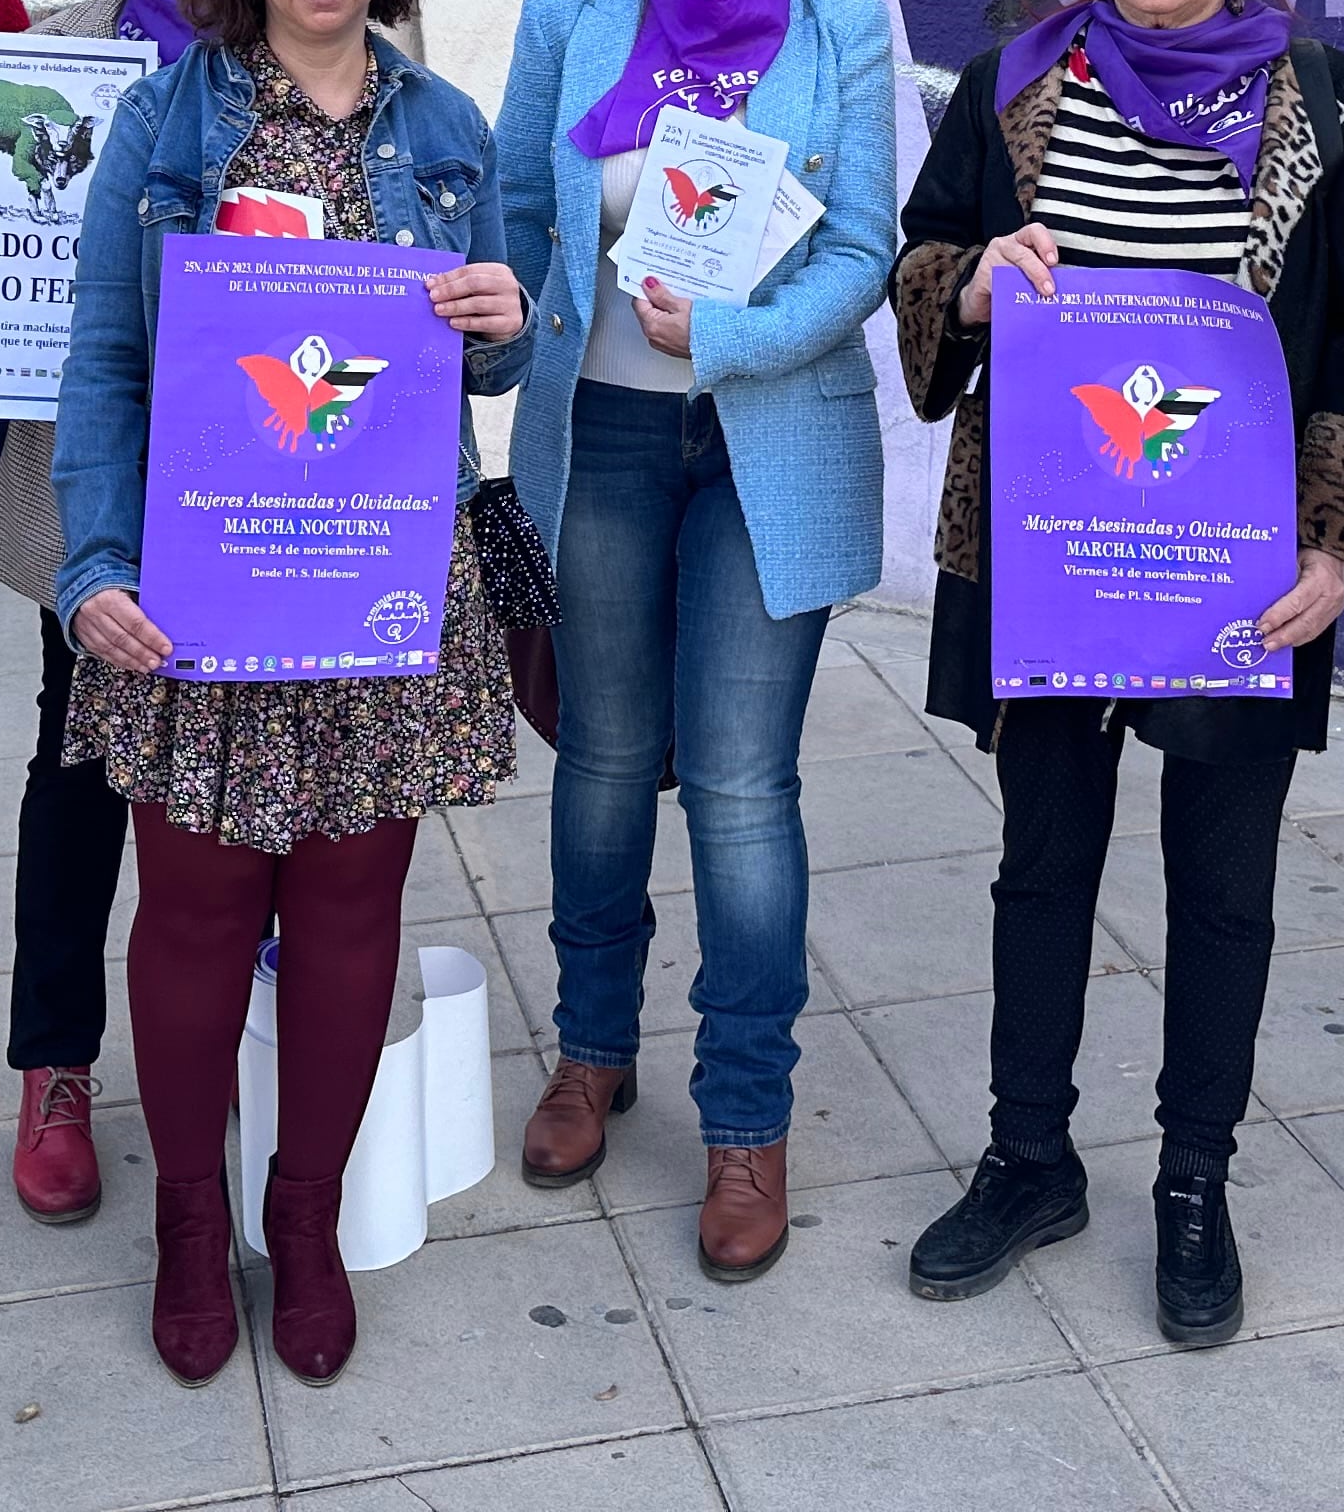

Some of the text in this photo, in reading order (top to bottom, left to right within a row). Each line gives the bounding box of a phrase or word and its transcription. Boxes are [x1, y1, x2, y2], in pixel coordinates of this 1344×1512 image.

[228, 279, 243, 291] DE
[244, 280, 257, 292] LA
[260, 280, 312, 293] VIOLENCIA
[314, 281, 356, 294] CONTRA
[357, 283, 370, 295] LA
[0, 337, 20, 348] que
[22, 337, 32, 347] te
[34, 337, 69, 350] quiere
[245, 491, 334, 509] Asesinadas
[335, 497, 346, 513] y
[349, 492, 438, 510] Olvidadas."
[223, 517, 391, 536] MARCHA NOCTURNA
[1086, 515, 1173, 535] Asesinadas
[1174, 524, 1185, 539] y
[1188, 520, 1278, 541] Olvidadas."
[219, 542, 392, 556] Viernes 24 de noviembre.18h.
[1065, 540, 1231, 564] MARCHA NOCTURNA
[1063, 563, 1234, 583] Viernes 24 de noviembre.18h.
